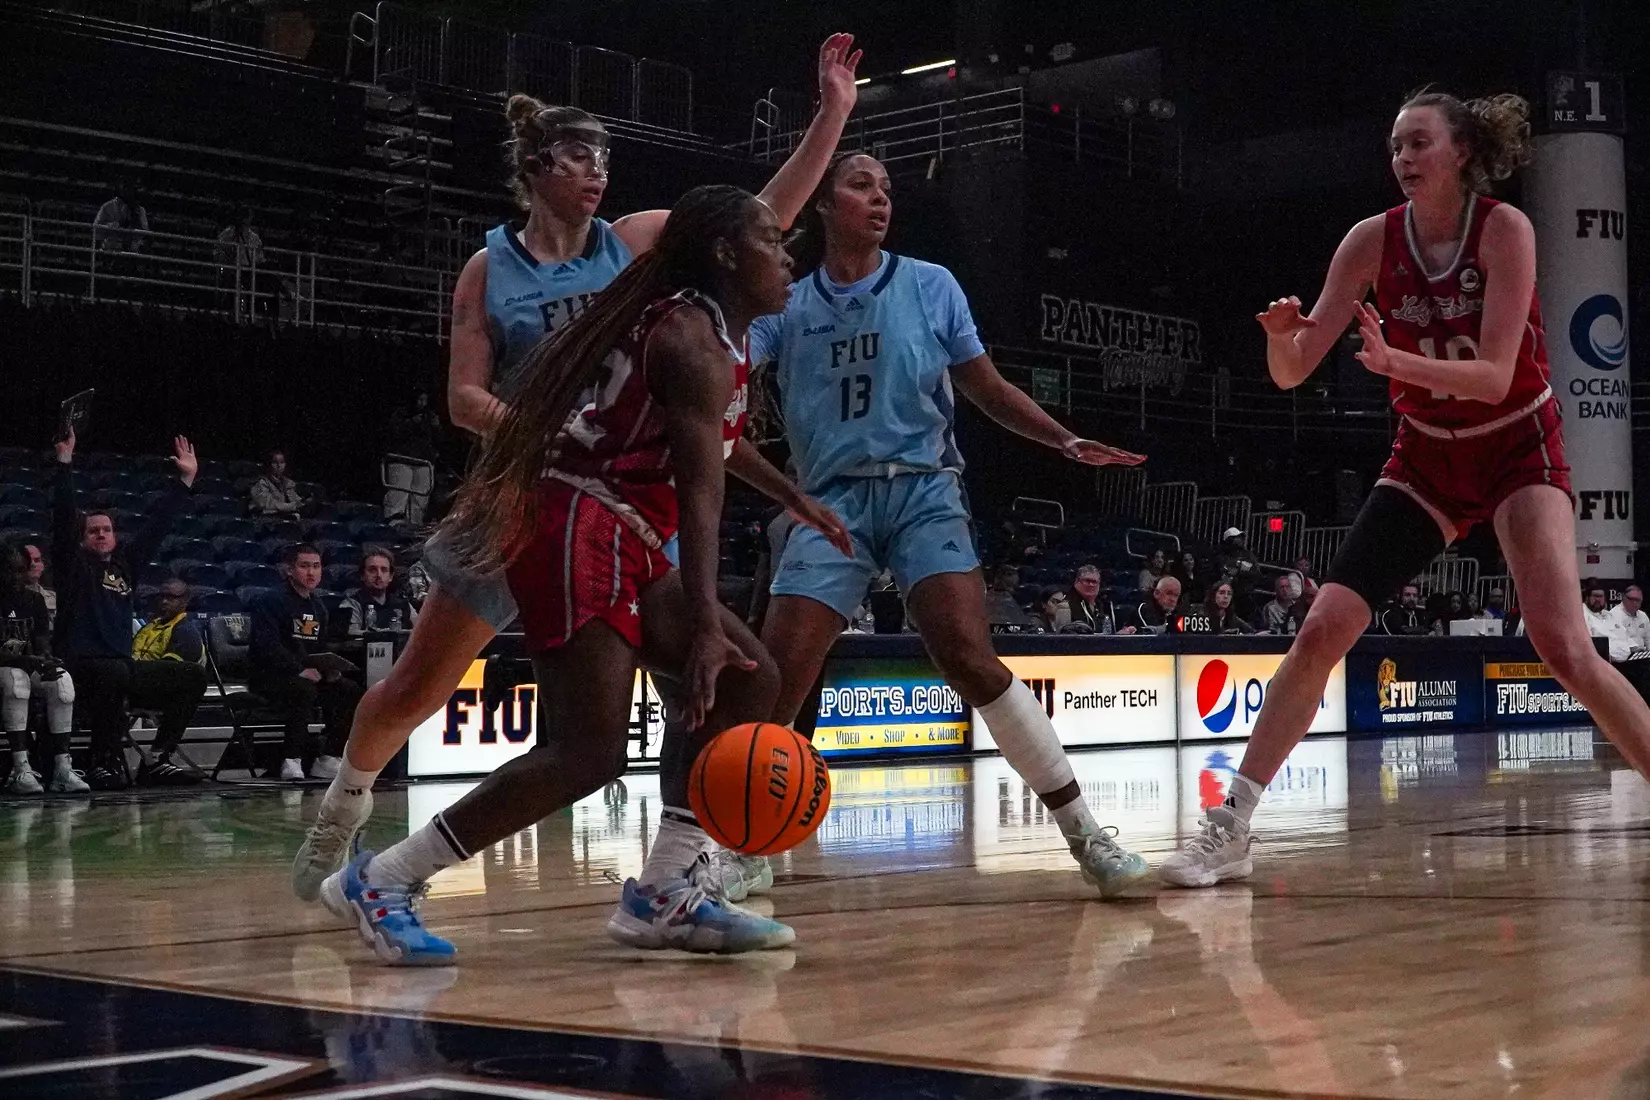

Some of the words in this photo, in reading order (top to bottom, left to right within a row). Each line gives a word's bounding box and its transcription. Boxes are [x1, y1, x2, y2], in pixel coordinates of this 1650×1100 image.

[1554, 110, 1578, 122] N.E.
[1584, 81, 1607, 122] 1
[1576, 209, 1624, 240] FIU
[1041, 293, 1202, 364] PANTHER
[830, 332, 880, 368] FIU
[840, 374, 872, 422] 13
[1569, 378, 1629, 397] OCEAN
[1578, 401, 1628, 420] BANK
[1579, 490, 1629, 520] FIU
[819, 684, 963, 718] PORTS.COM
[1064, 690, 1117, 709] Panther
[1120, 689, 1157, 708] TECH
[1390, 681, 1417, 708] FIU
[1418, 680, 1457, 697] ALUMNI
[1418, 697, 1457, 707] ASSOCIATION
[442, 687, 536, 745] FIU
